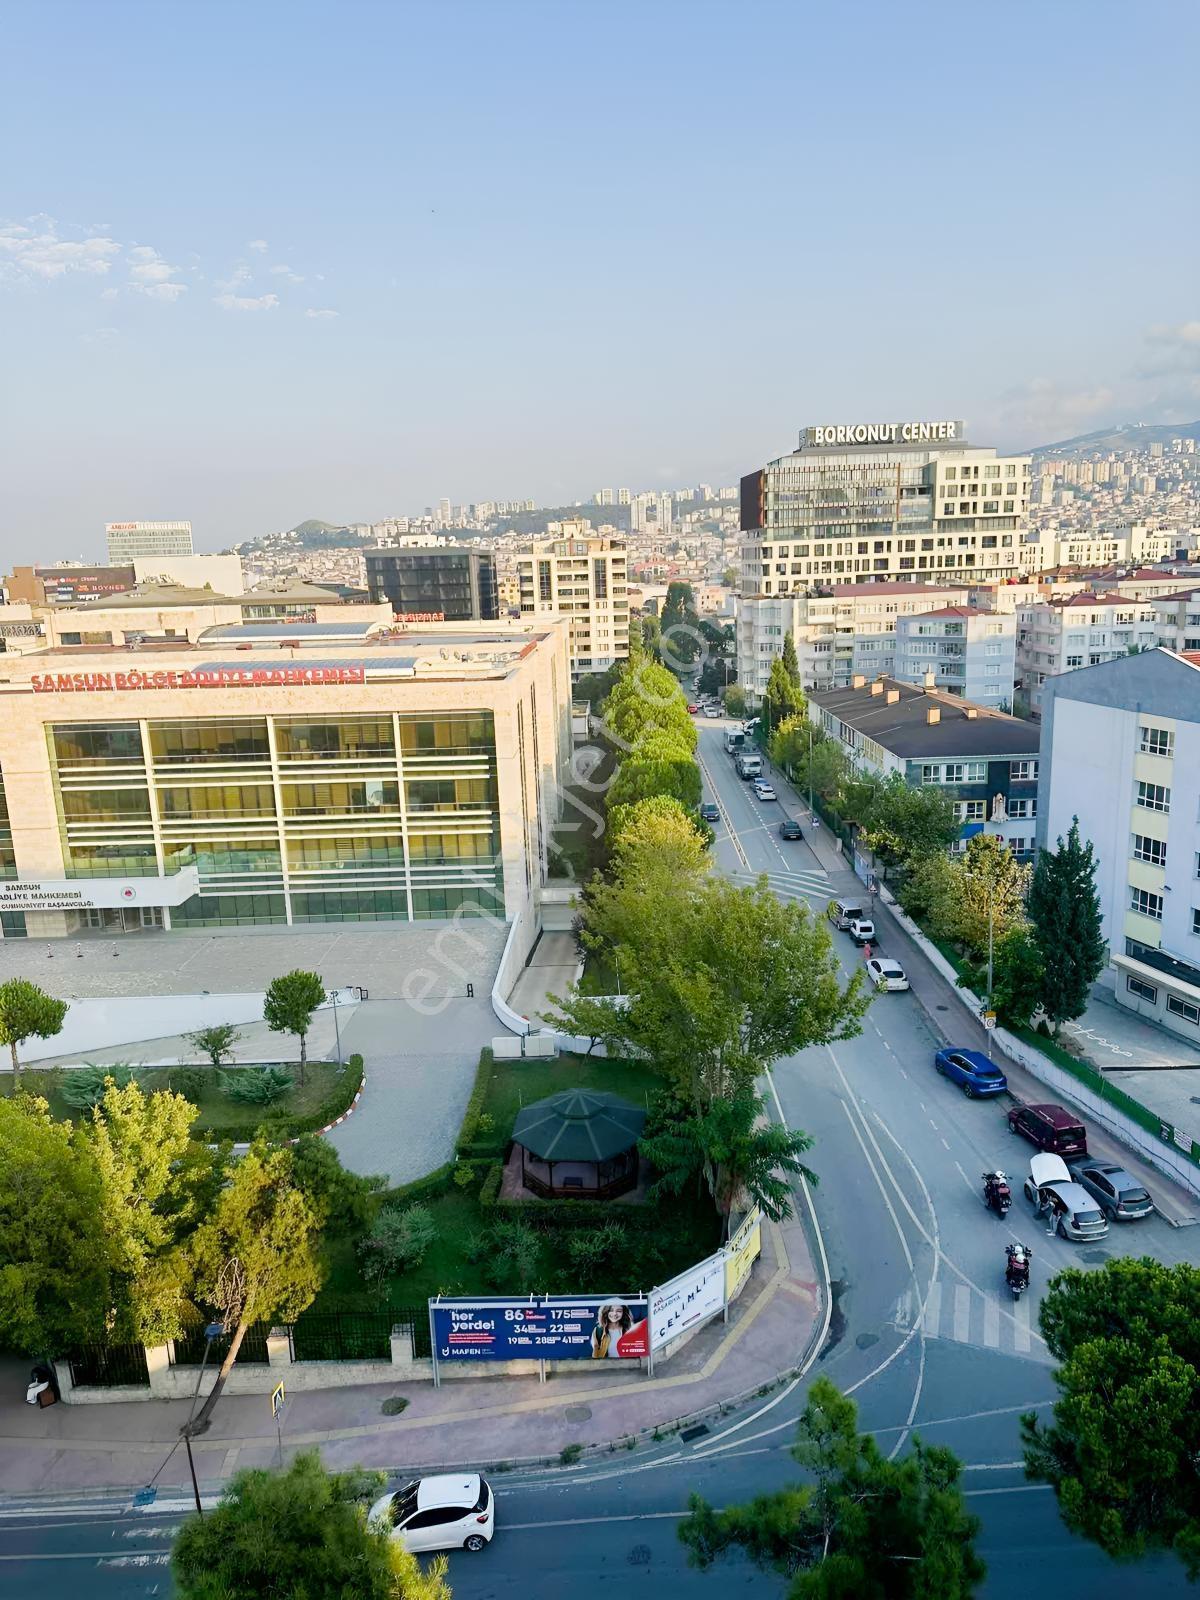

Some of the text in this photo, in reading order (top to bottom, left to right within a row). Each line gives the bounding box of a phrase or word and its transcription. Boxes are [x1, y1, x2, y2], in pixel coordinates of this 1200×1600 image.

[815, 421, 955, 443] BORKONUT CENTER
[31, 671, 112, 690] SAMSUN
[115, 669, 176, 688] BÖLGE
[504, 1309, 524, 1321] 86
[551, 1309, 571, 1320] 175
[513, 1324, 528, 1333] 34
[550, 1324, 564, 1333] 22
[508, 1337, 518, 1345] 19
[562, 1336, 572, 1344] 41
